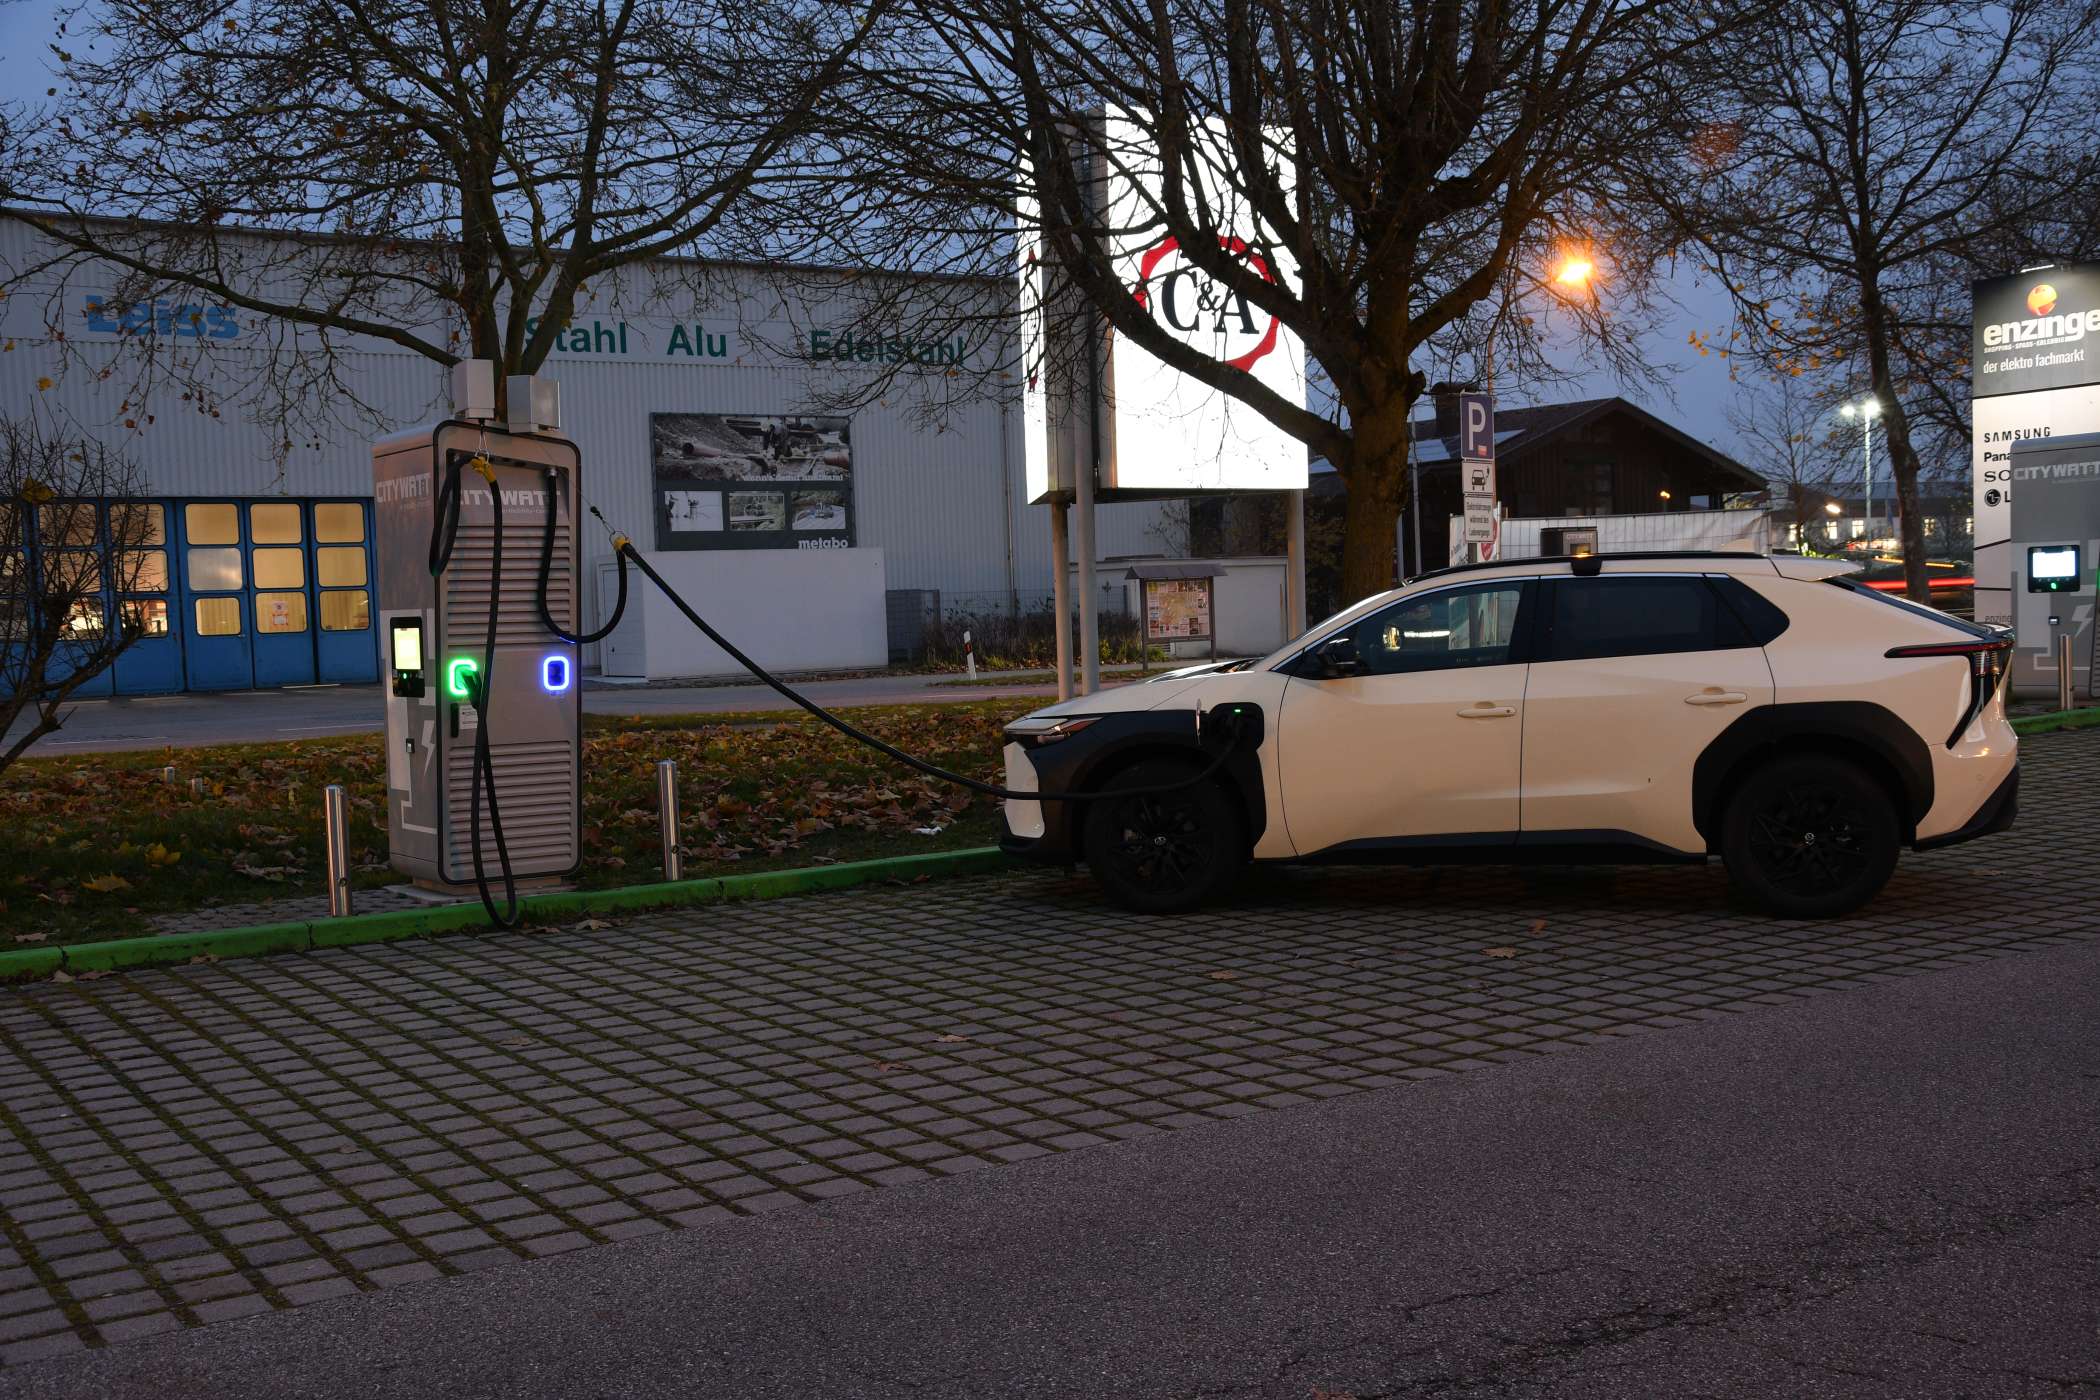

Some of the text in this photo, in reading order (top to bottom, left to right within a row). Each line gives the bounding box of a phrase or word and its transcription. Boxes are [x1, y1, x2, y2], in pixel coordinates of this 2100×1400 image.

[1161, 270, 1260, 335] C&A
[86, 295, 240, 339] Leiss
[666, 324, 727, 357] Alu
[811, 330, 965, 365] Edelstahl
[1983, 349, 2085, 374] der elektro fachmarkt
[1468, 401, 1486, 451] P
[1984, 426, 2052, 444] SAMSUNG
[2014, 461, 2100, 481] CITYWATT
[376, 472, 432, 503] CITYWATT
[460, 489, 561, 506] ITYWAT
[798, 537, 849, 550] metabo
